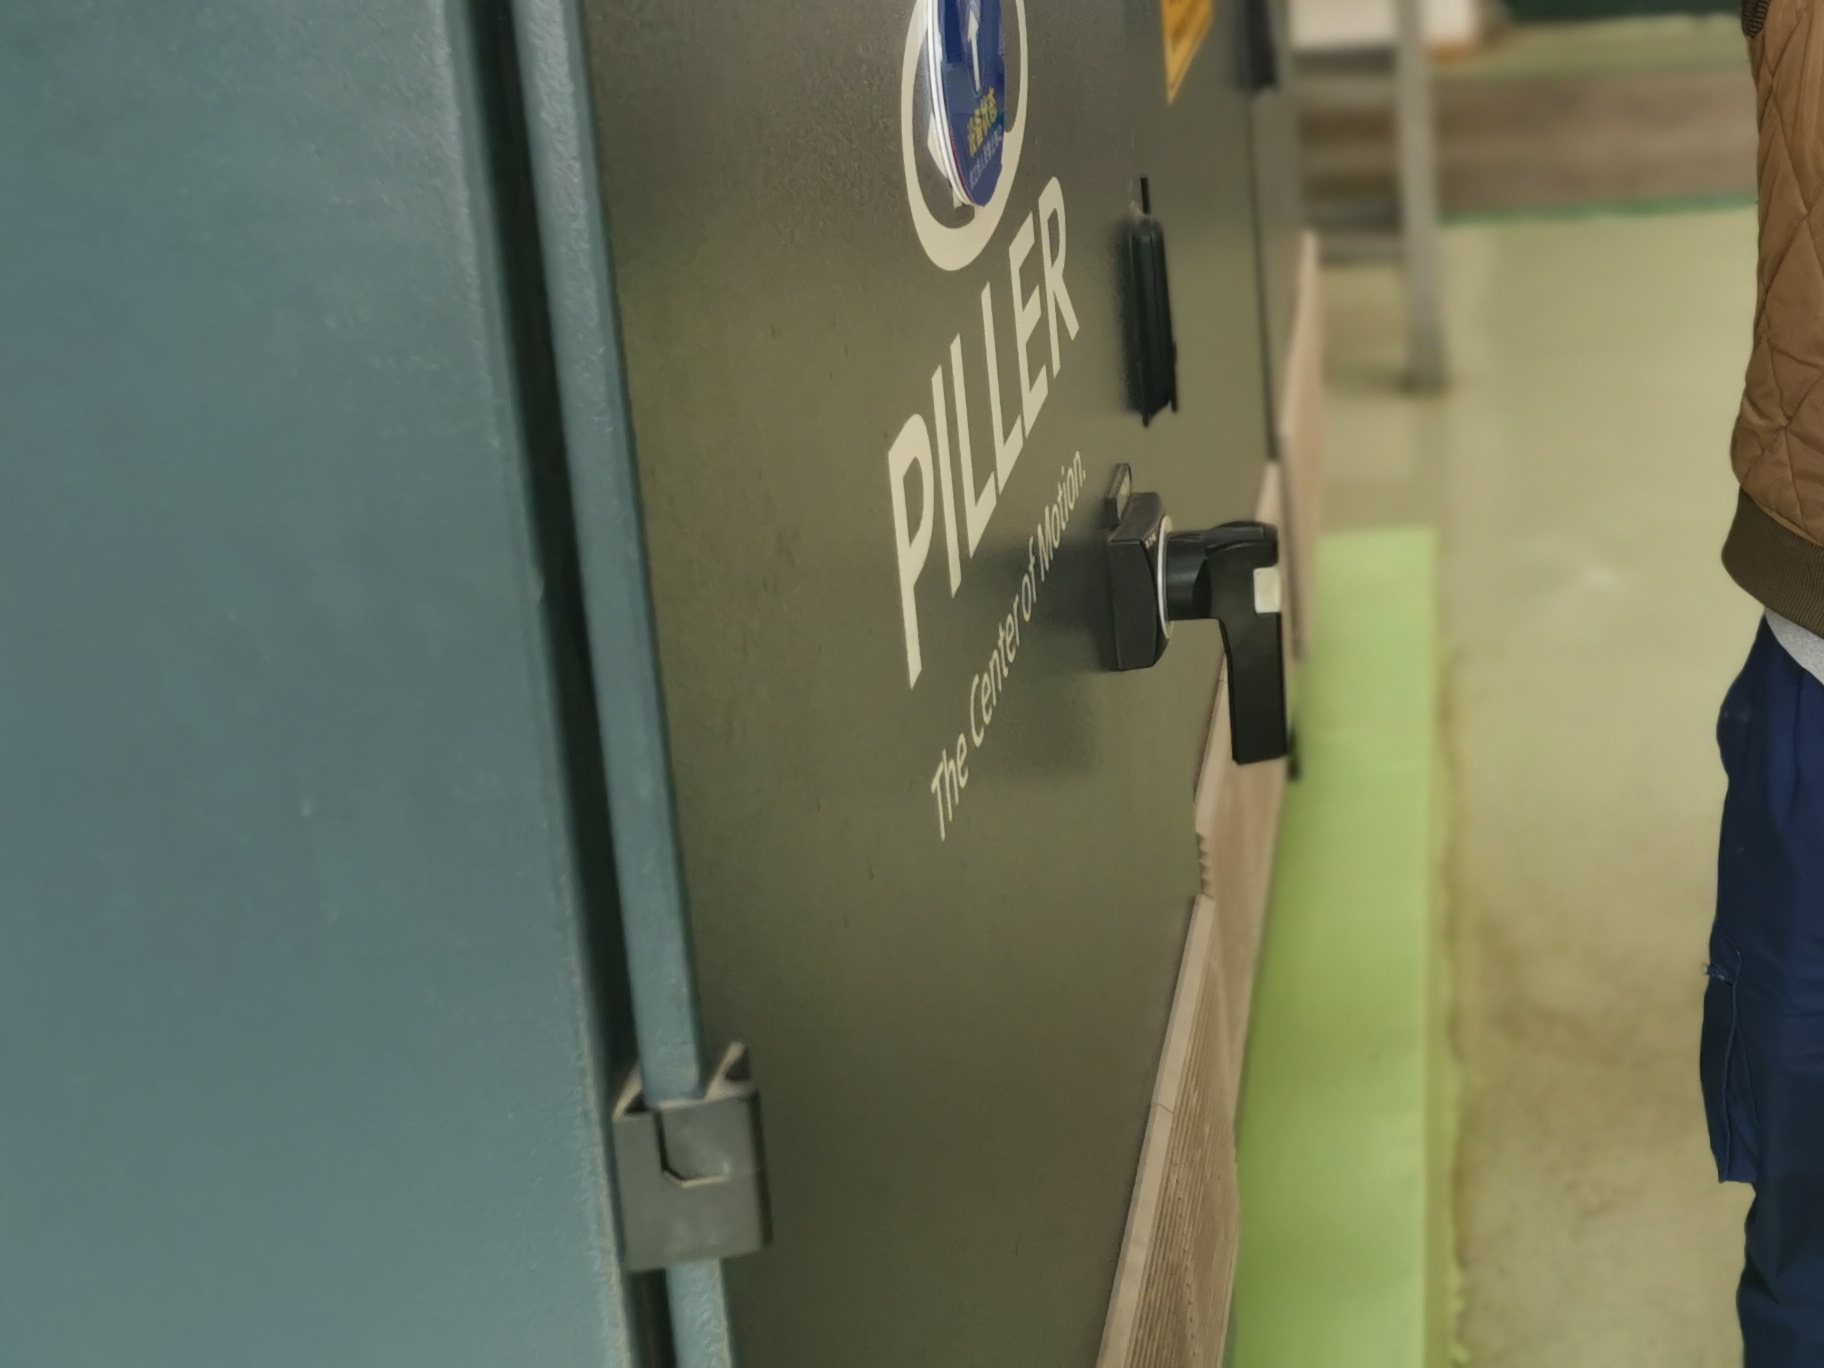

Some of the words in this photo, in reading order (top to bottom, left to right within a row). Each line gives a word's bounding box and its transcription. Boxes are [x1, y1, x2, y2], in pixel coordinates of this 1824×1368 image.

[888, 176, 1079, 689] PILLER
[931, 733, 969, 842] The
[970, 594, 1020, 748] Center
[1021, 535, 1038, 623] of
[1038, 450, 1087, 582] Motion.
